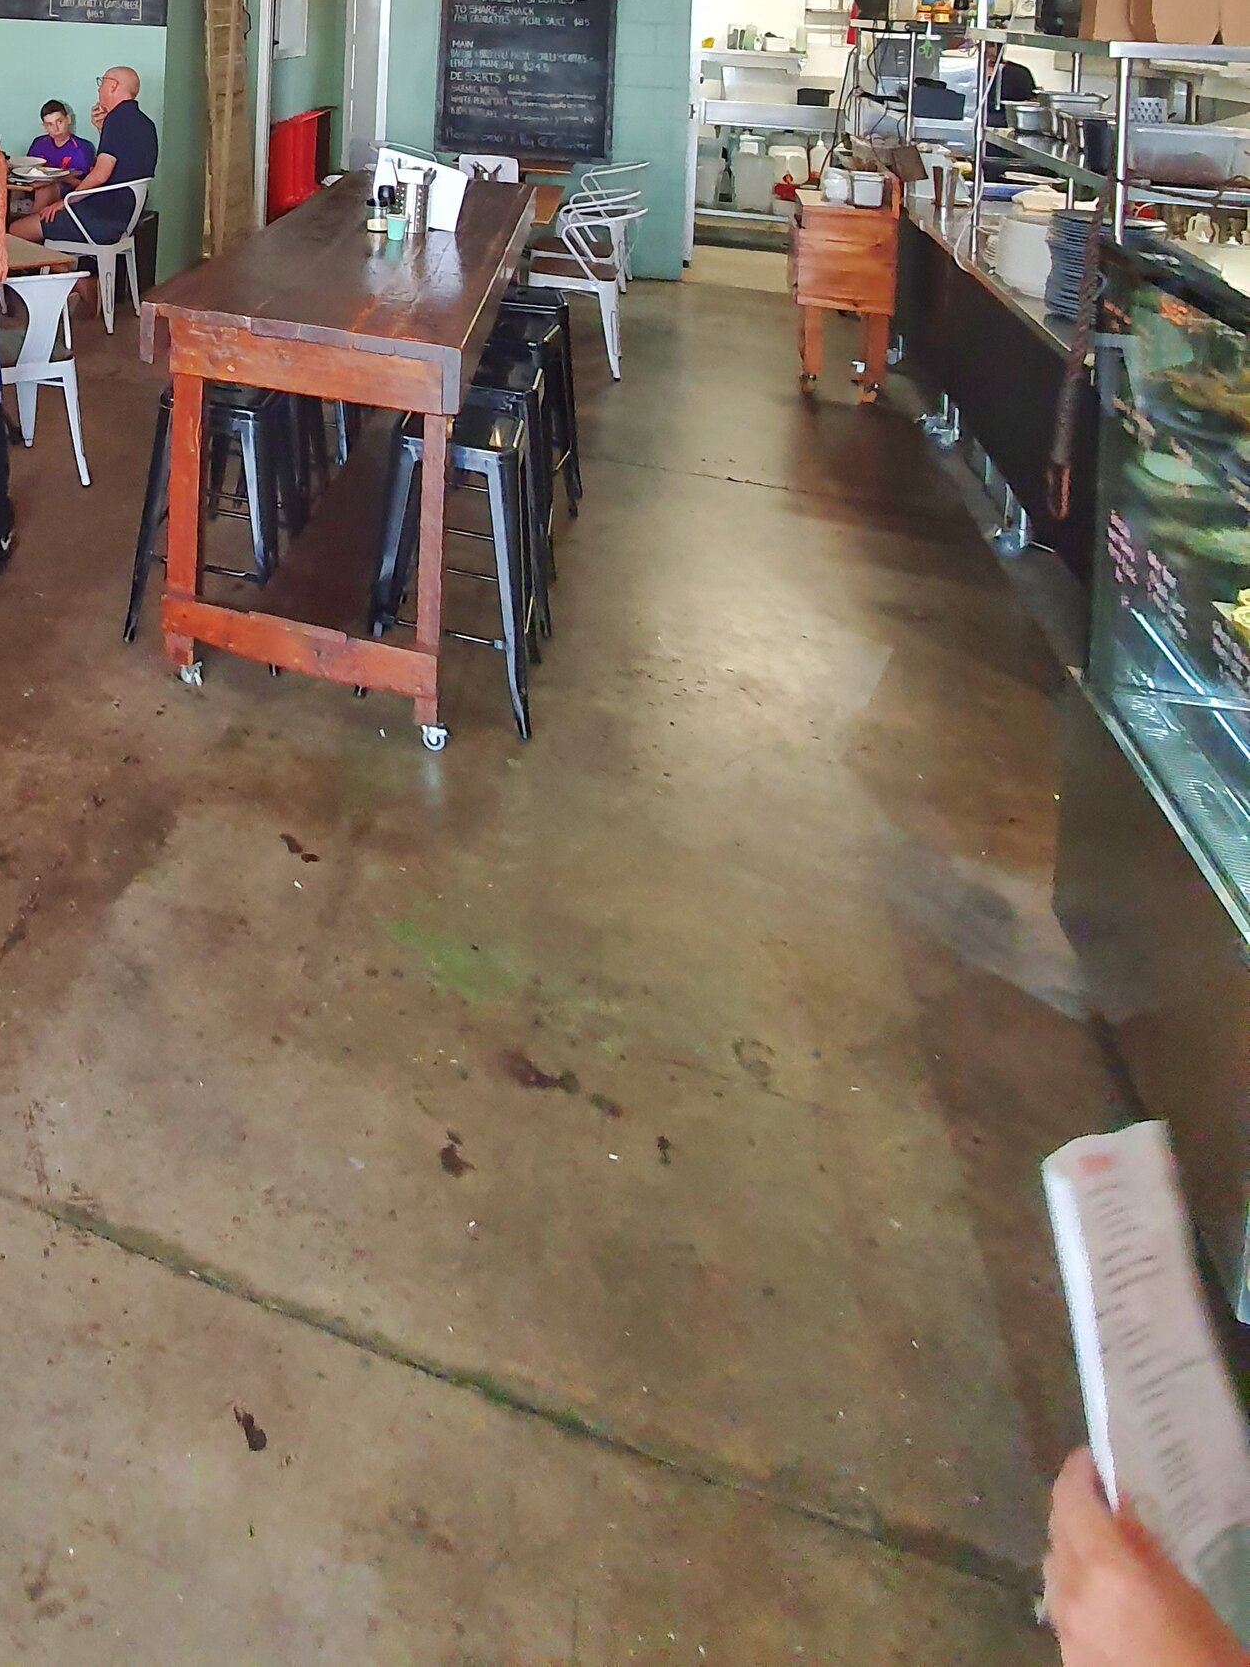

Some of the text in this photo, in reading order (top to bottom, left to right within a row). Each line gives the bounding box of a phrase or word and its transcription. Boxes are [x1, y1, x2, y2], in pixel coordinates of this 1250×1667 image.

[454, 5, 467, 14] TO
[452, 40, 474, 49] MAIN
[449, 71, 501, 84] DESSERTS
